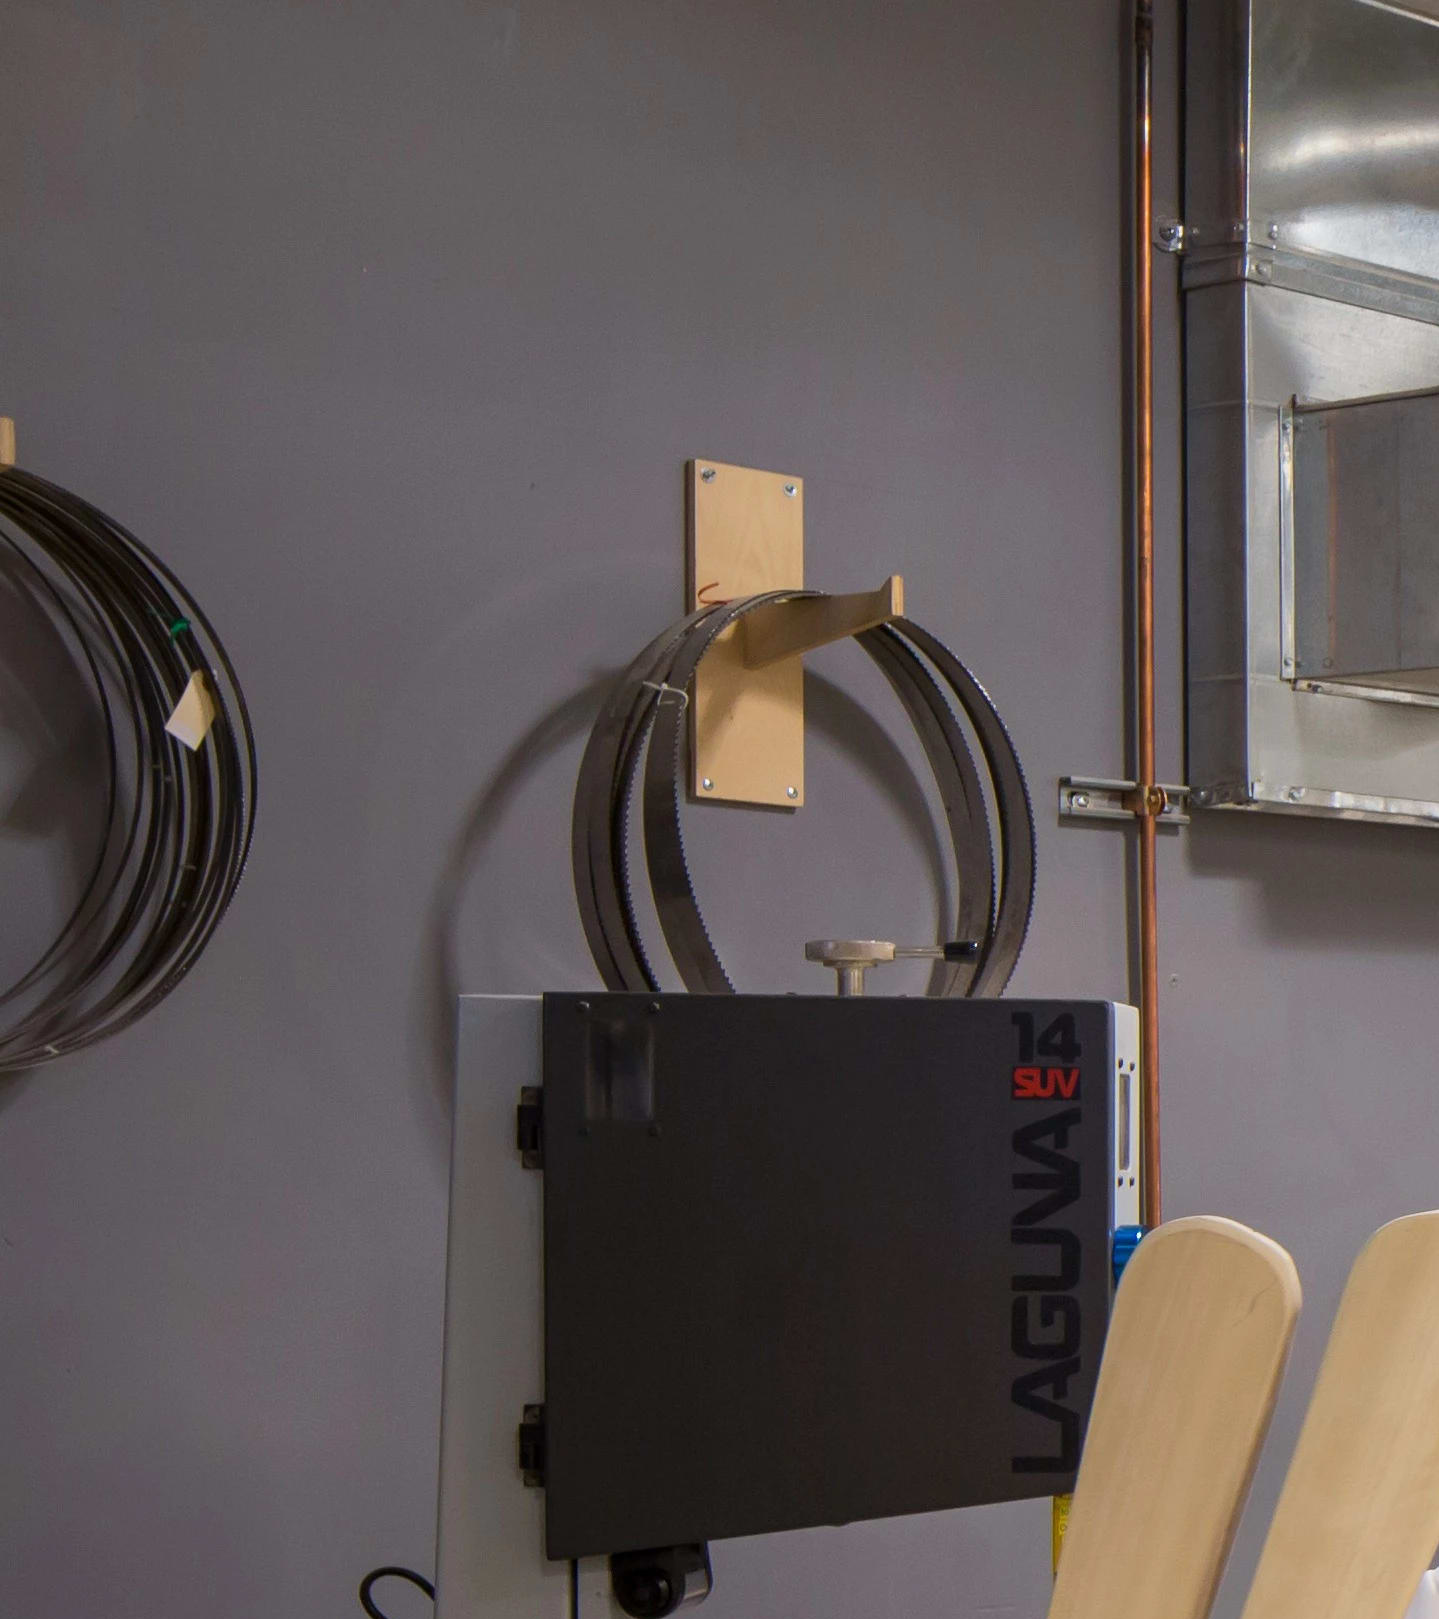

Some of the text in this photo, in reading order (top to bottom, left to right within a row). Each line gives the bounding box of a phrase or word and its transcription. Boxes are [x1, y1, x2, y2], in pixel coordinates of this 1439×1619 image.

[1011, 1012, 1082, 1063] 14
[1013, 1067, 1080, 1099] SUV
[1011, 1107, 1082, 1475] LAGUNA
